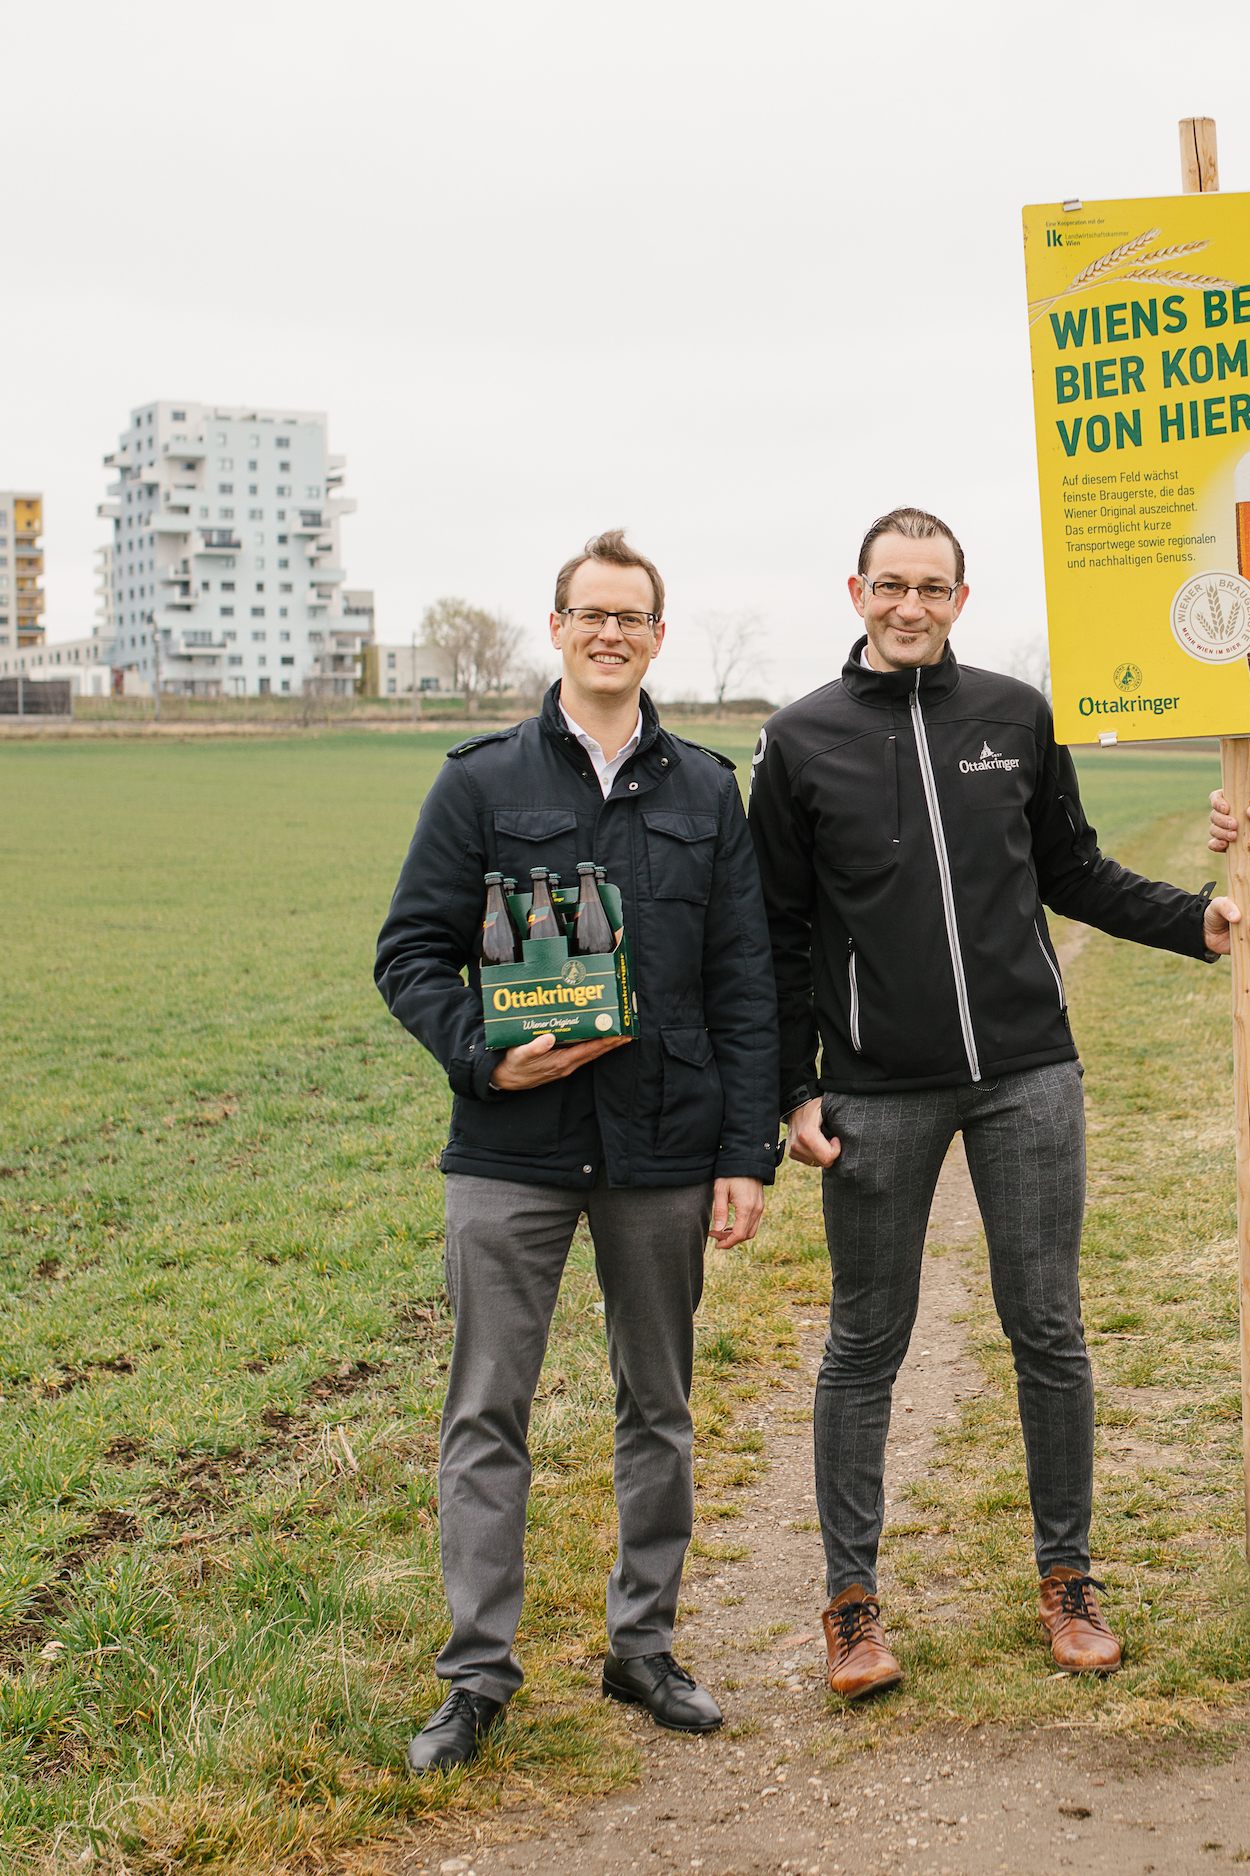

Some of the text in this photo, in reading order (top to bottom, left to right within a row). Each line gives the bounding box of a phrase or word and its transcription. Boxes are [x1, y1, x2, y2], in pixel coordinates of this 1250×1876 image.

[1049, 295, 1188, 350] WIENS
[1054, 355, 1146, 404] BIER
[1055, 408, 1142, 458] VON
[1062, 469, 1179, 486] Auf diesem Feld wächst
[1063, 485, 1195, 503] feinste Braugerste, die das
[1064, 502, 1198, 519] Wiener Original auszeichnet.
[1065, 520, 1172, 536] Das ermöglicht kurze
[1066, 534, 1216, 553] Transportwege sowie regionalen
[1067, 553, 1196, 568] und nachhaltigen Genuss.
[1178, 584, 1203, 622] WIENER
[1182, 627, 1196, 645] MEHR
[1196, 644, 1213, 654] WIEN
[1226, 642, 1241, 653] BIER
[1079, 696, 1180, 716] Ottakringer
[959, 758, 1020, 774] Ottakringer
[493, 984, 605, 1012] Ottakringer
[522, 1016, 580, 1030] Wiener Original
